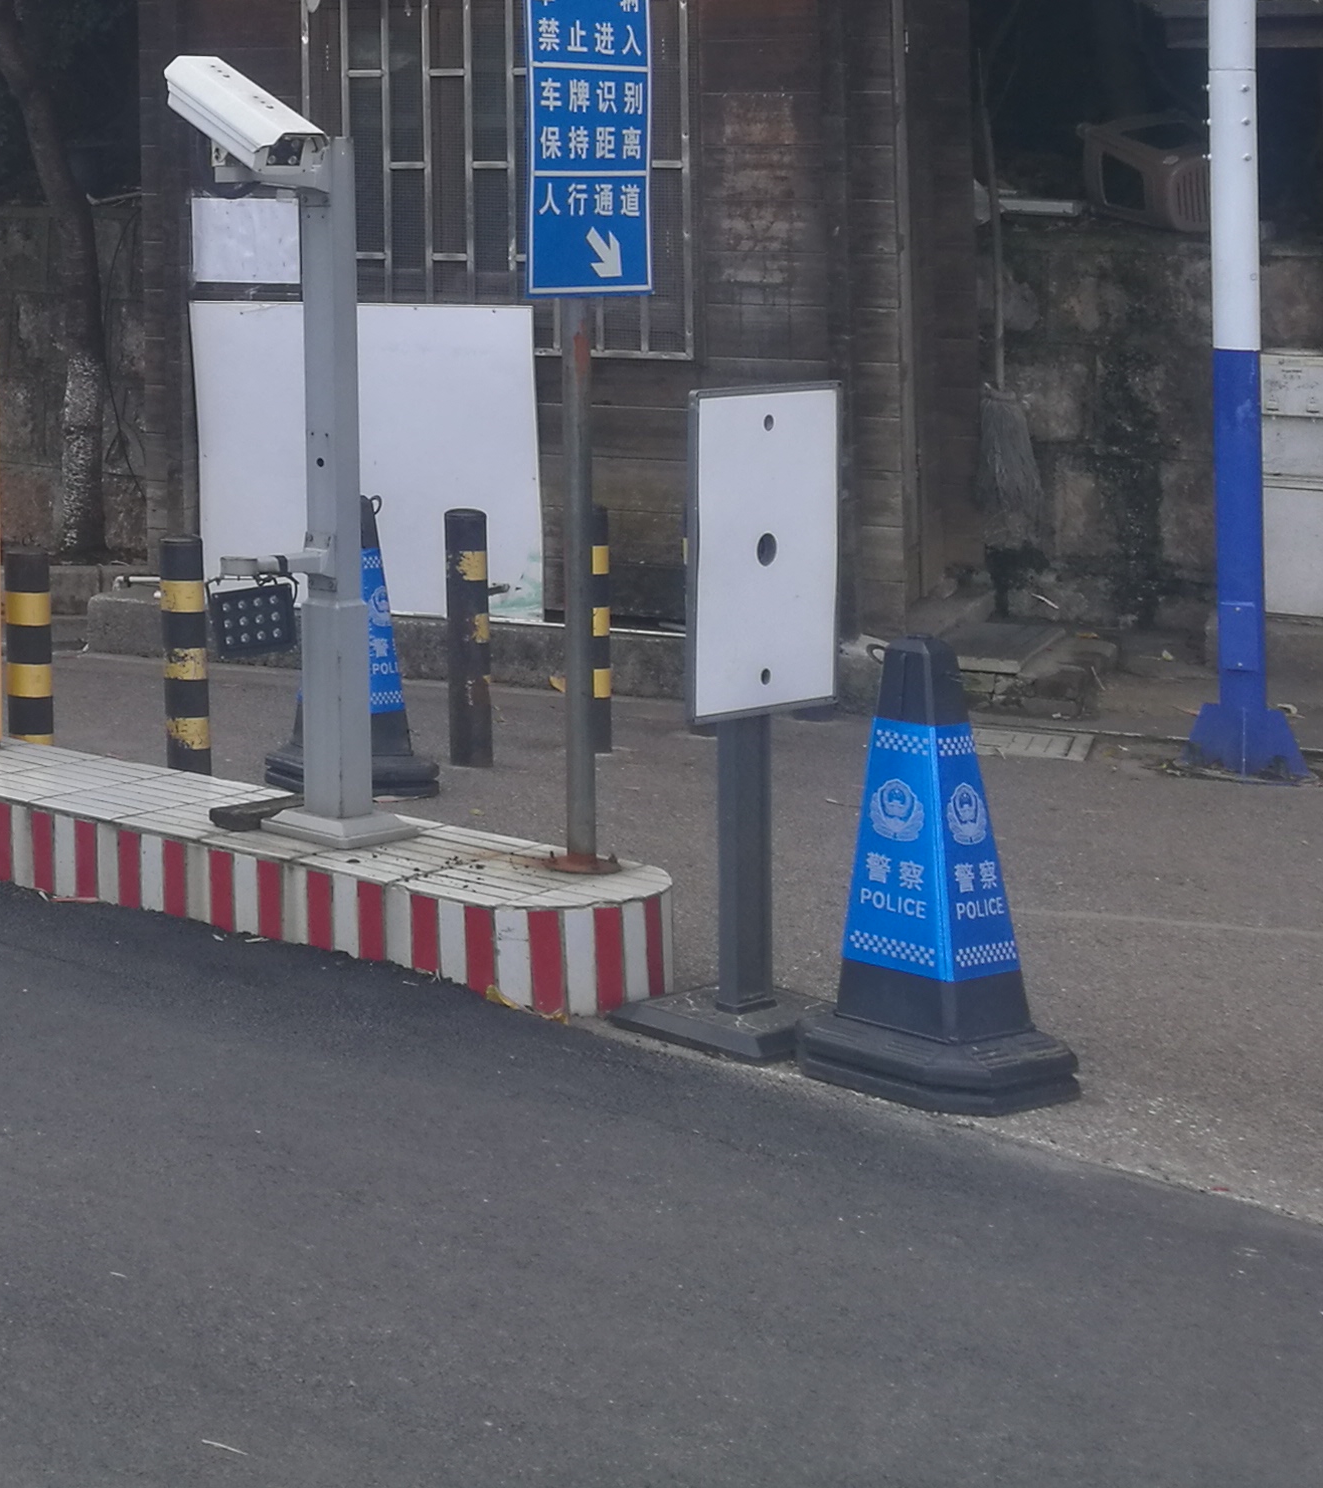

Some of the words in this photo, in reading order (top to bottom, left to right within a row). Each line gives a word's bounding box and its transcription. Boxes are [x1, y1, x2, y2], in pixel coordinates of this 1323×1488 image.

[537, 17, 643, 57] 禁止进入
[540, 78, 643, 115] 车牌识别
[540, 125, 642, 160] 保持距离
[539, 182, 641, 218] 人行通道
[865, 851, 925, 892] 警察
[954, 859, 998, 894] 警察
[860, 887, 927, 920] POLICE
[955, 896, 1005, 920] POLICE
